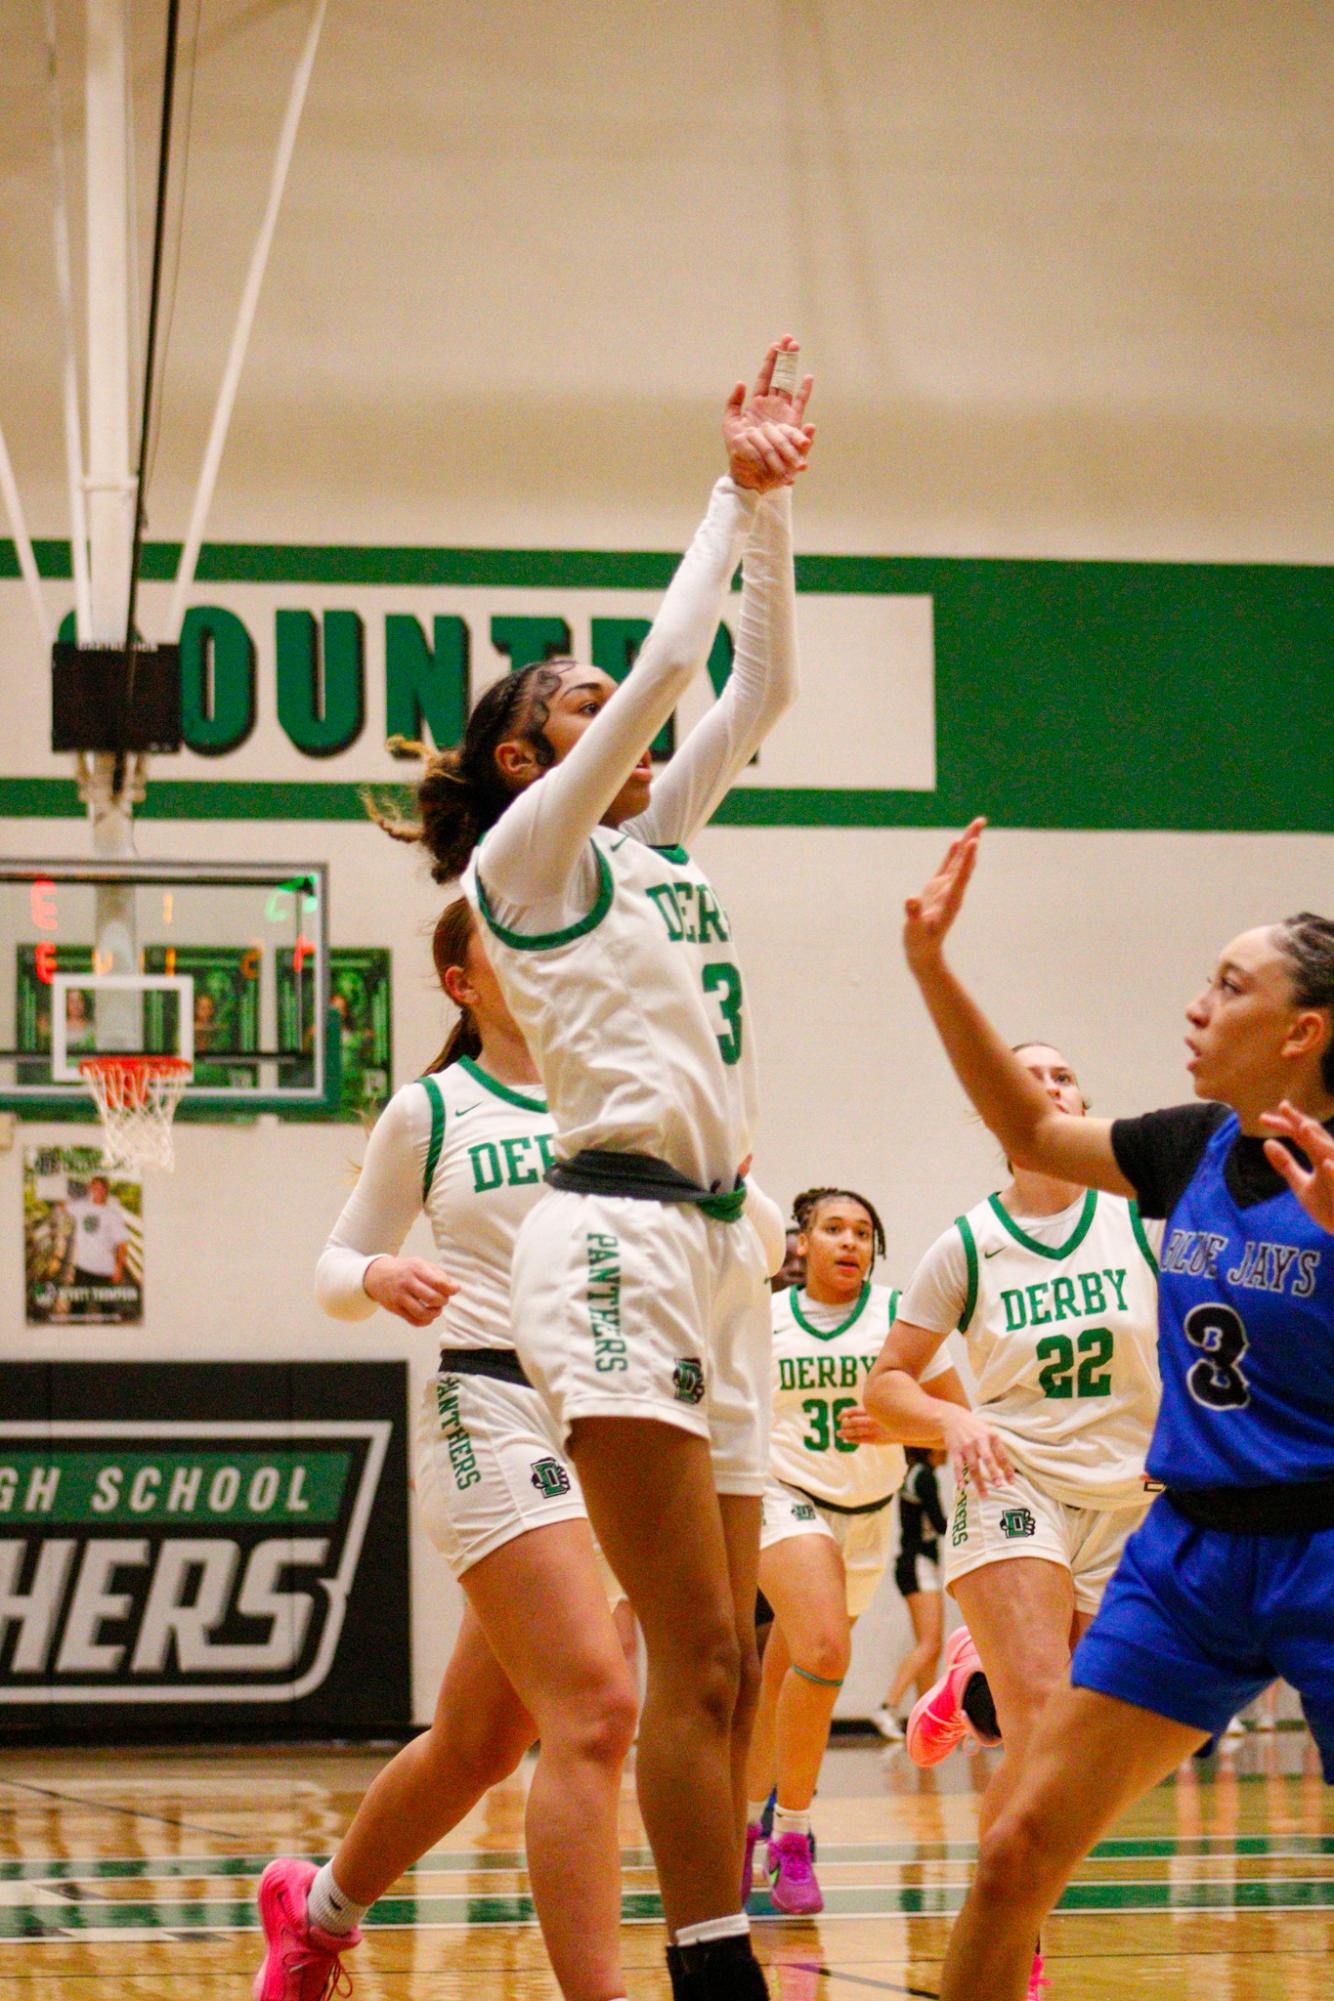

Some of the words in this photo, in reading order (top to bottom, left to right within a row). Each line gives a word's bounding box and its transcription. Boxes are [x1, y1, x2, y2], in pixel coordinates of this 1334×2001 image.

[645, 882, 732, 944] DER
[702, 962, 742, 1066] 3
[1000, 1268, 1129, 1333] DERBY
[1227, 1241, 1321, 1298] JAYS
[1036, 1327, 1114, 1399] 22
[1184, 1302, 1251, 1412] 3
[91, 1466, 311, 1513] SCHOOL
